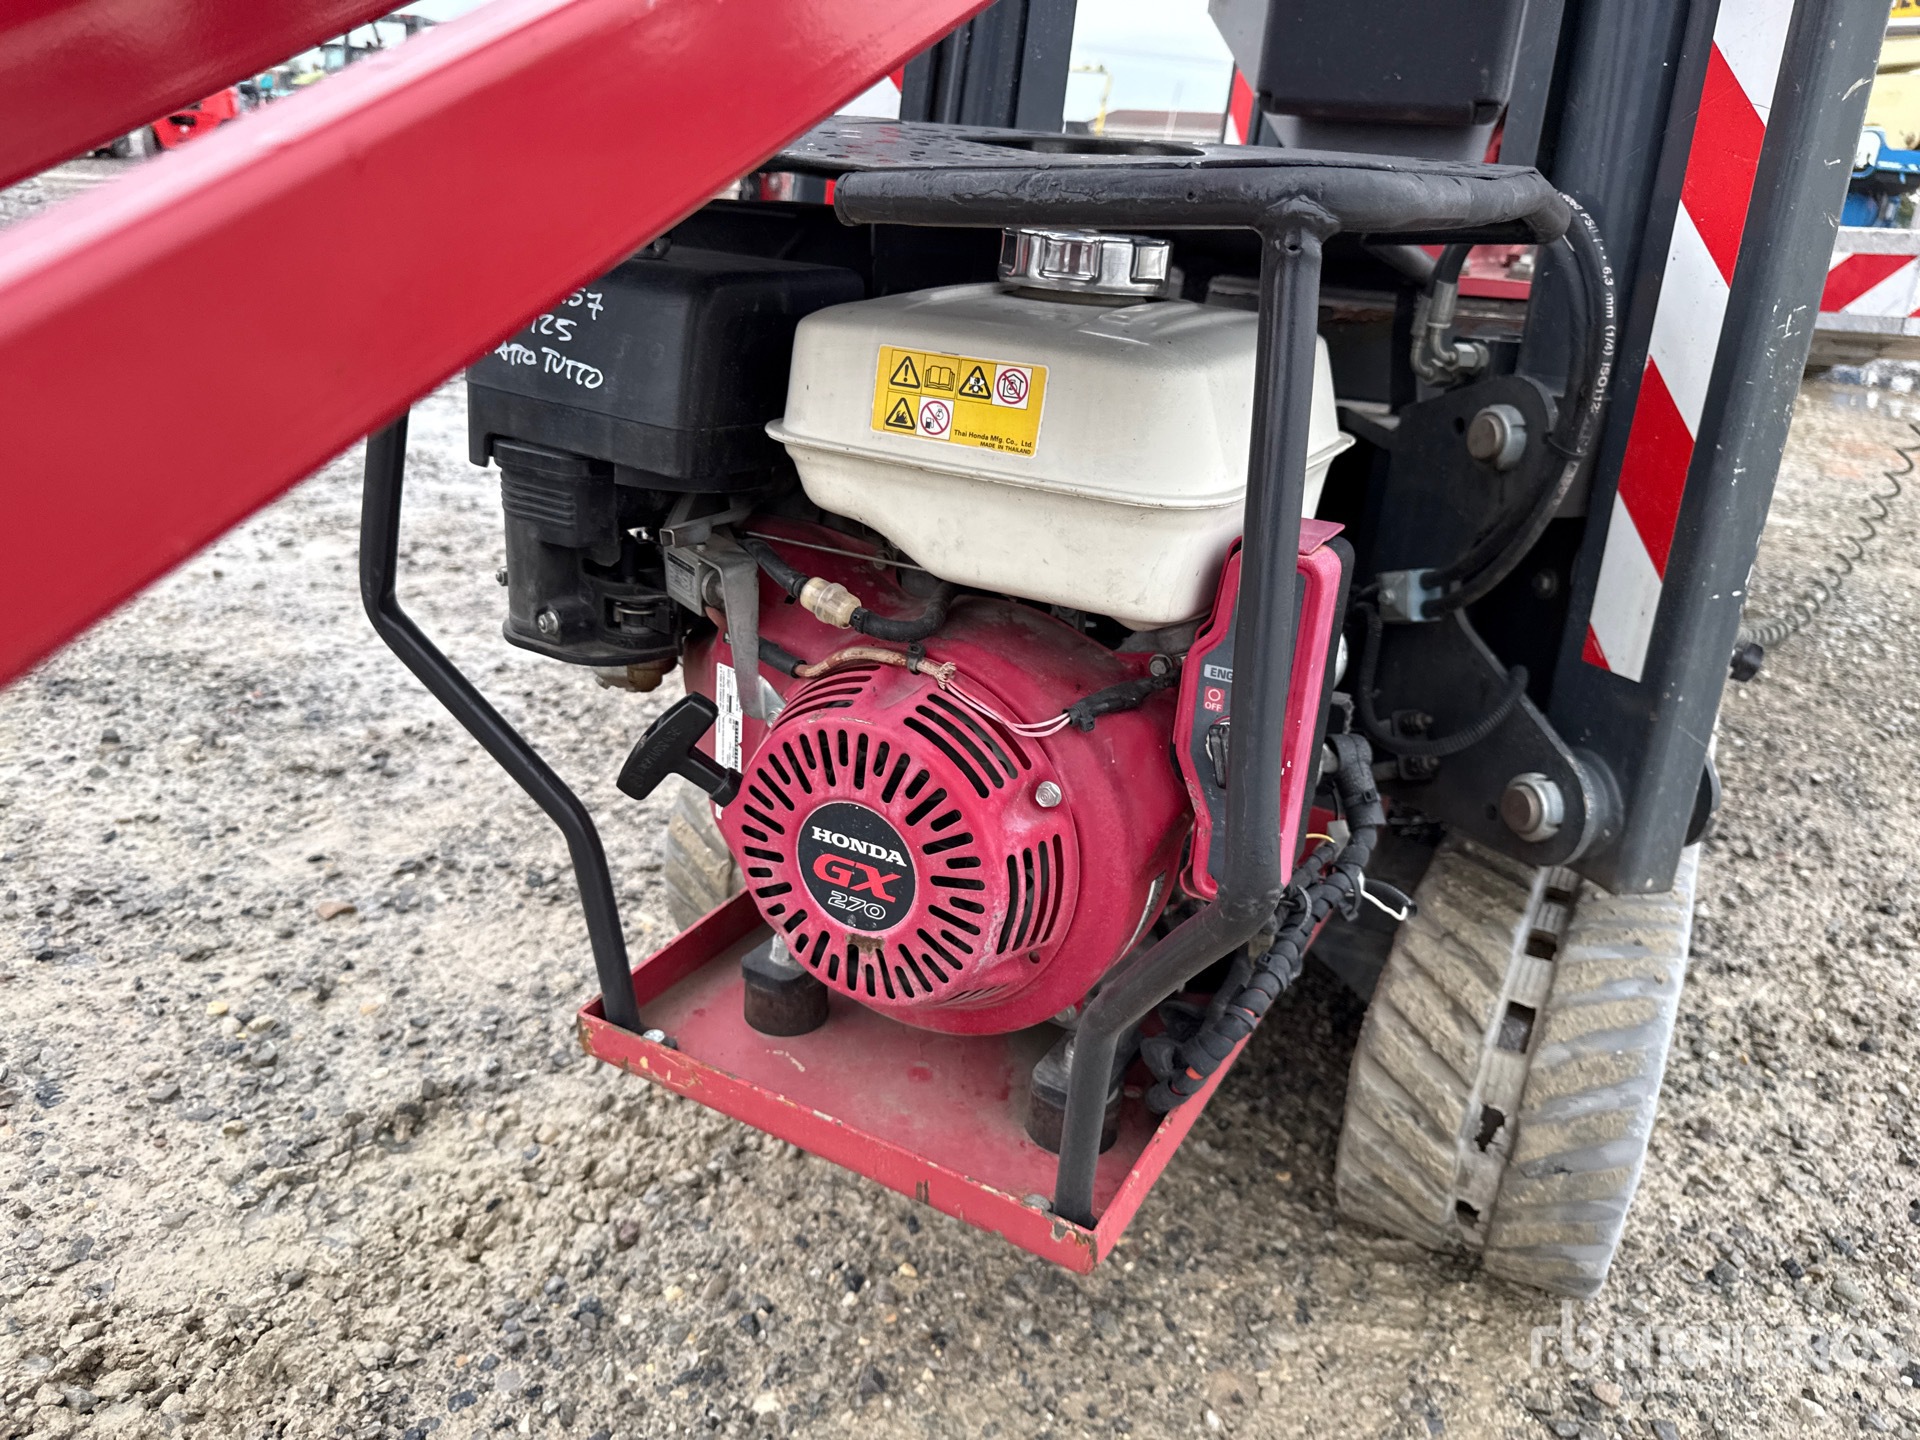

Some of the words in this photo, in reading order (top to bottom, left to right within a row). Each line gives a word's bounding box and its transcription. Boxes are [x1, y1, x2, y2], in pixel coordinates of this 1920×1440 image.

[1604, 292, 1615, 319] mm
[1602, 324, 1617, 356] (1/4)
[493, 341, 537, 366] ATTO
[541, 346, 604, 389] TUTTO
[954, 429, 967, 437] Thai
[968, 432, 989, 441] Honda
[1021, 440, 1033, 448] Ltd.
[979, 441, 995, 449] MADE
[1005, 445, 1032, 455] THAILAND
[1210, 667, 1233, 680] ENG
[1204, 701, 1223, 712] OFF
[811, 825, 908, 868] HONDA
[812, 853, 902, 904] GX
[827, 890, 887, 920] 270
